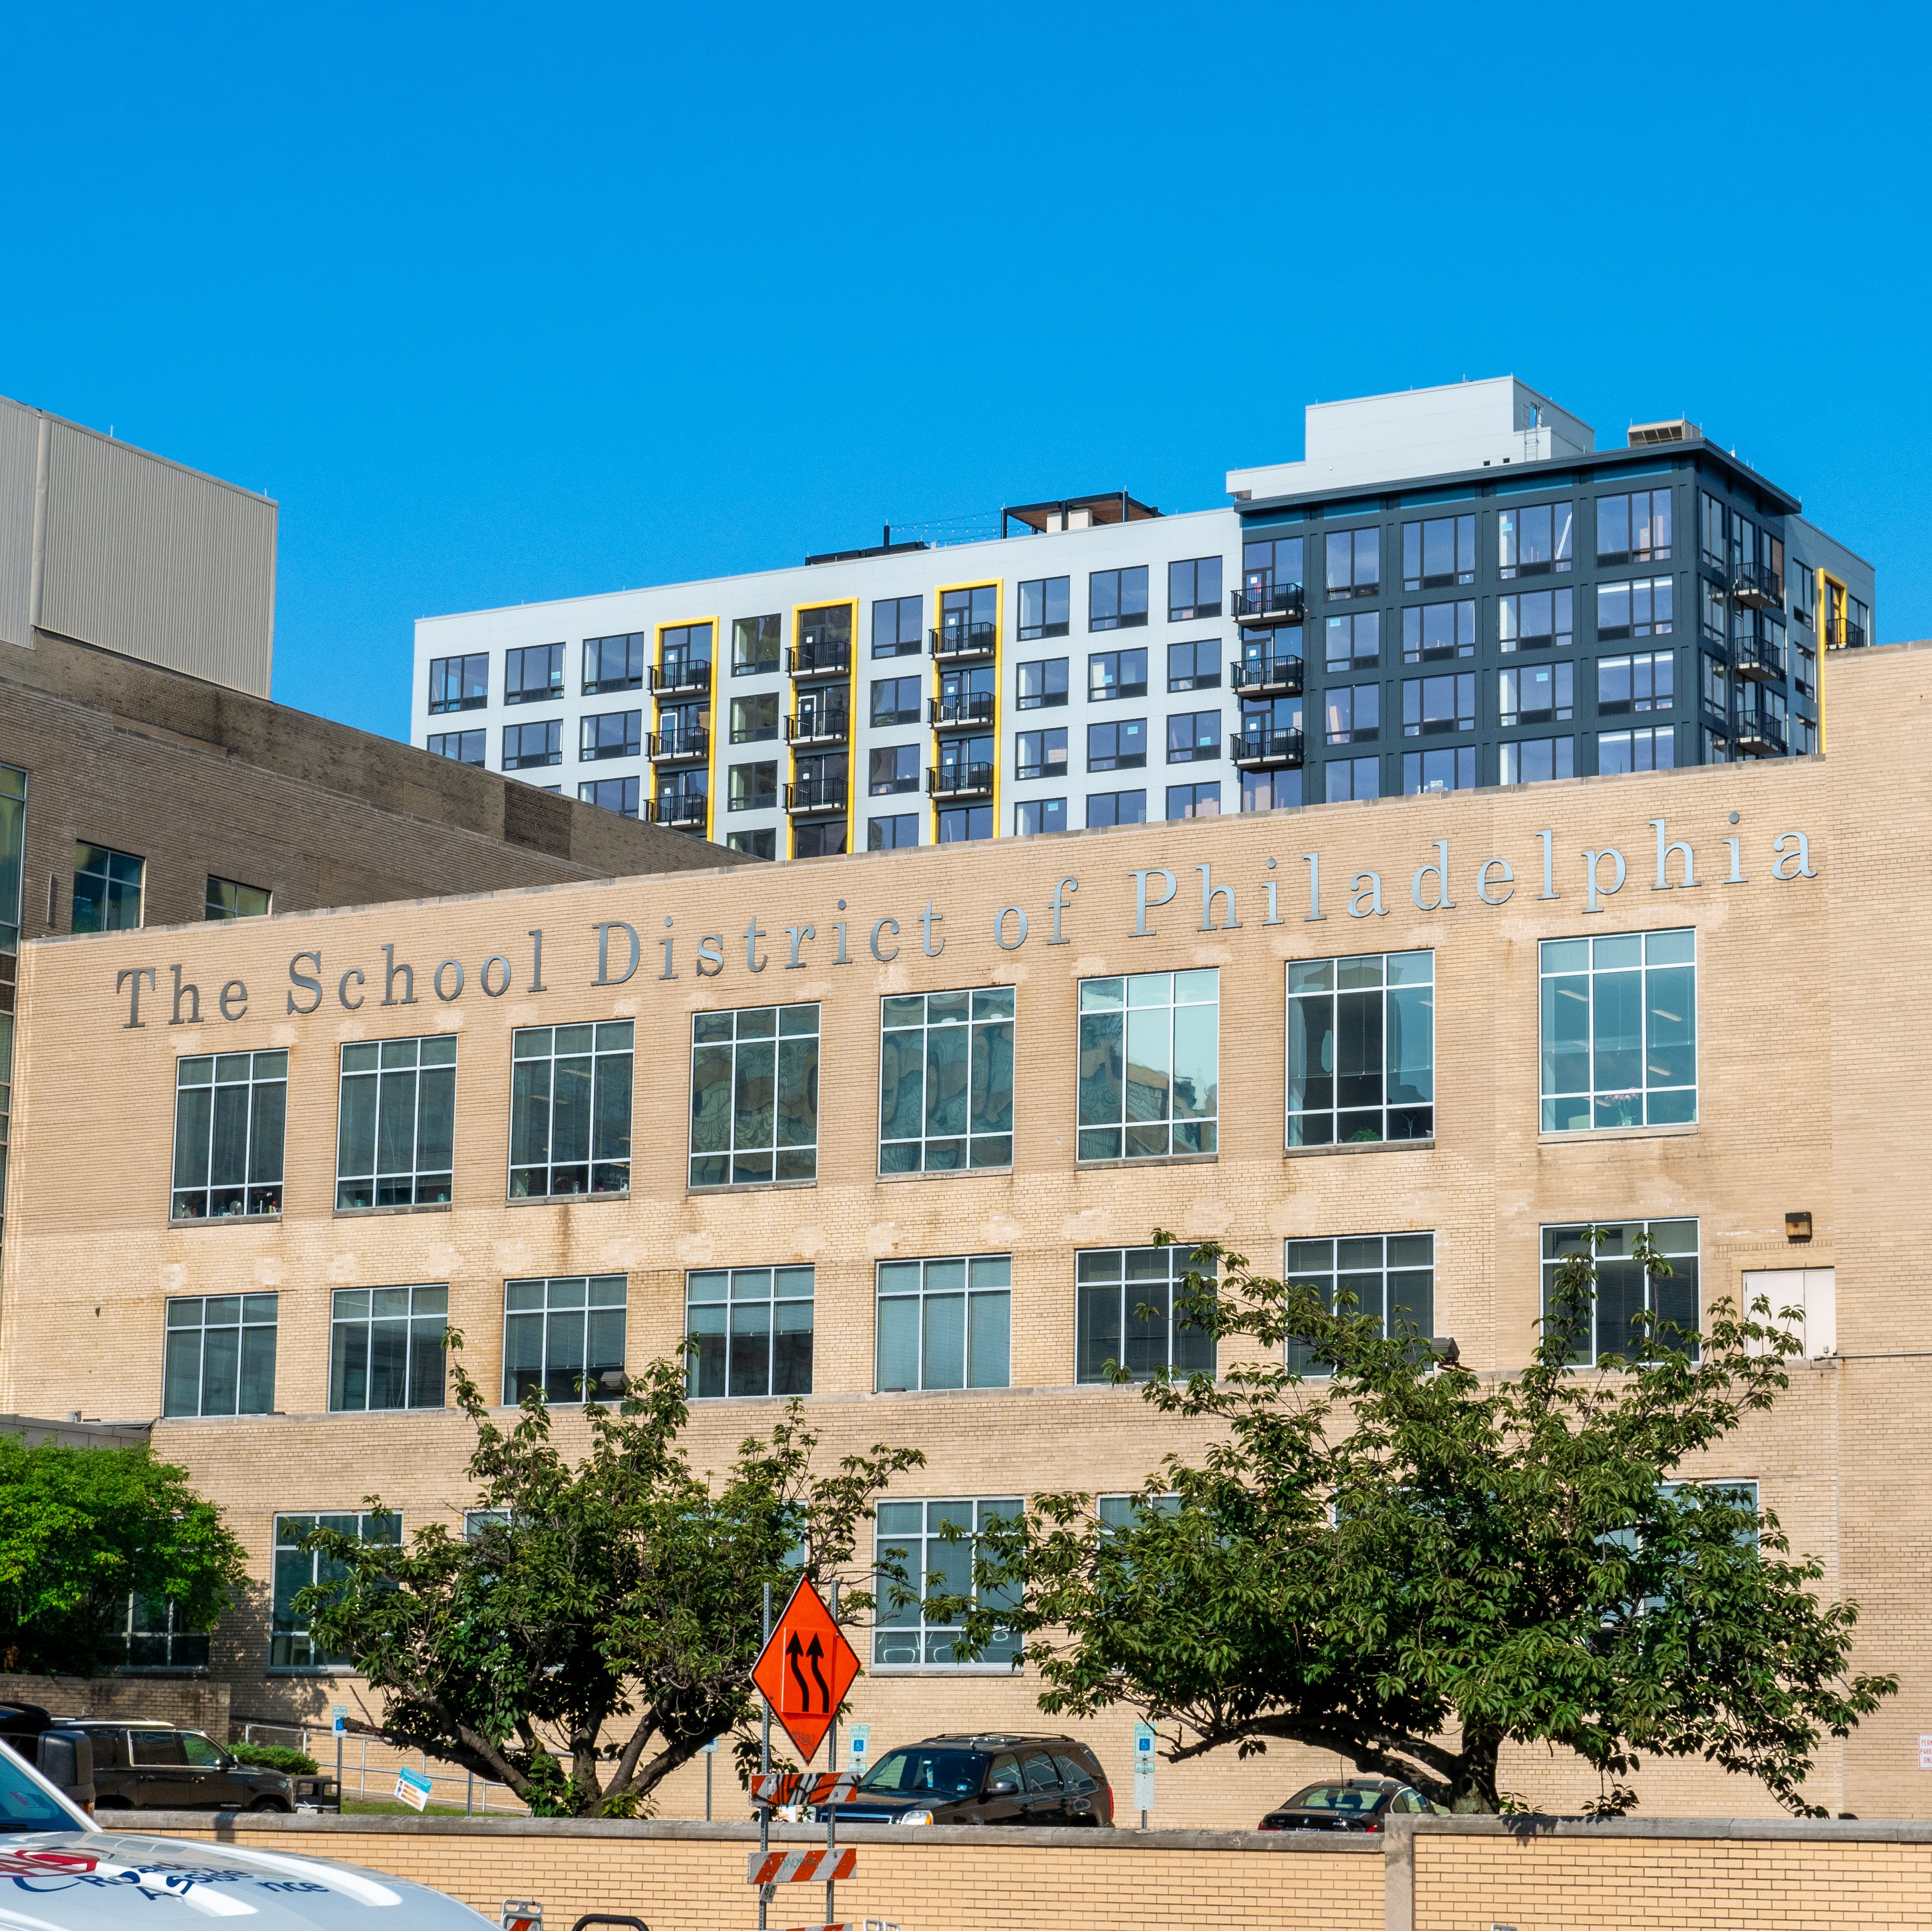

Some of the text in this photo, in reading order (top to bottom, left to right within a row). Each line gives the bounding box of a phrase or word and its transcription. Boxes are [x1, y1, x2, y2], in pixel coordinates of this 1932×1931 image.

[116, 812, 1818, 1029] The School District of Philadelphia
